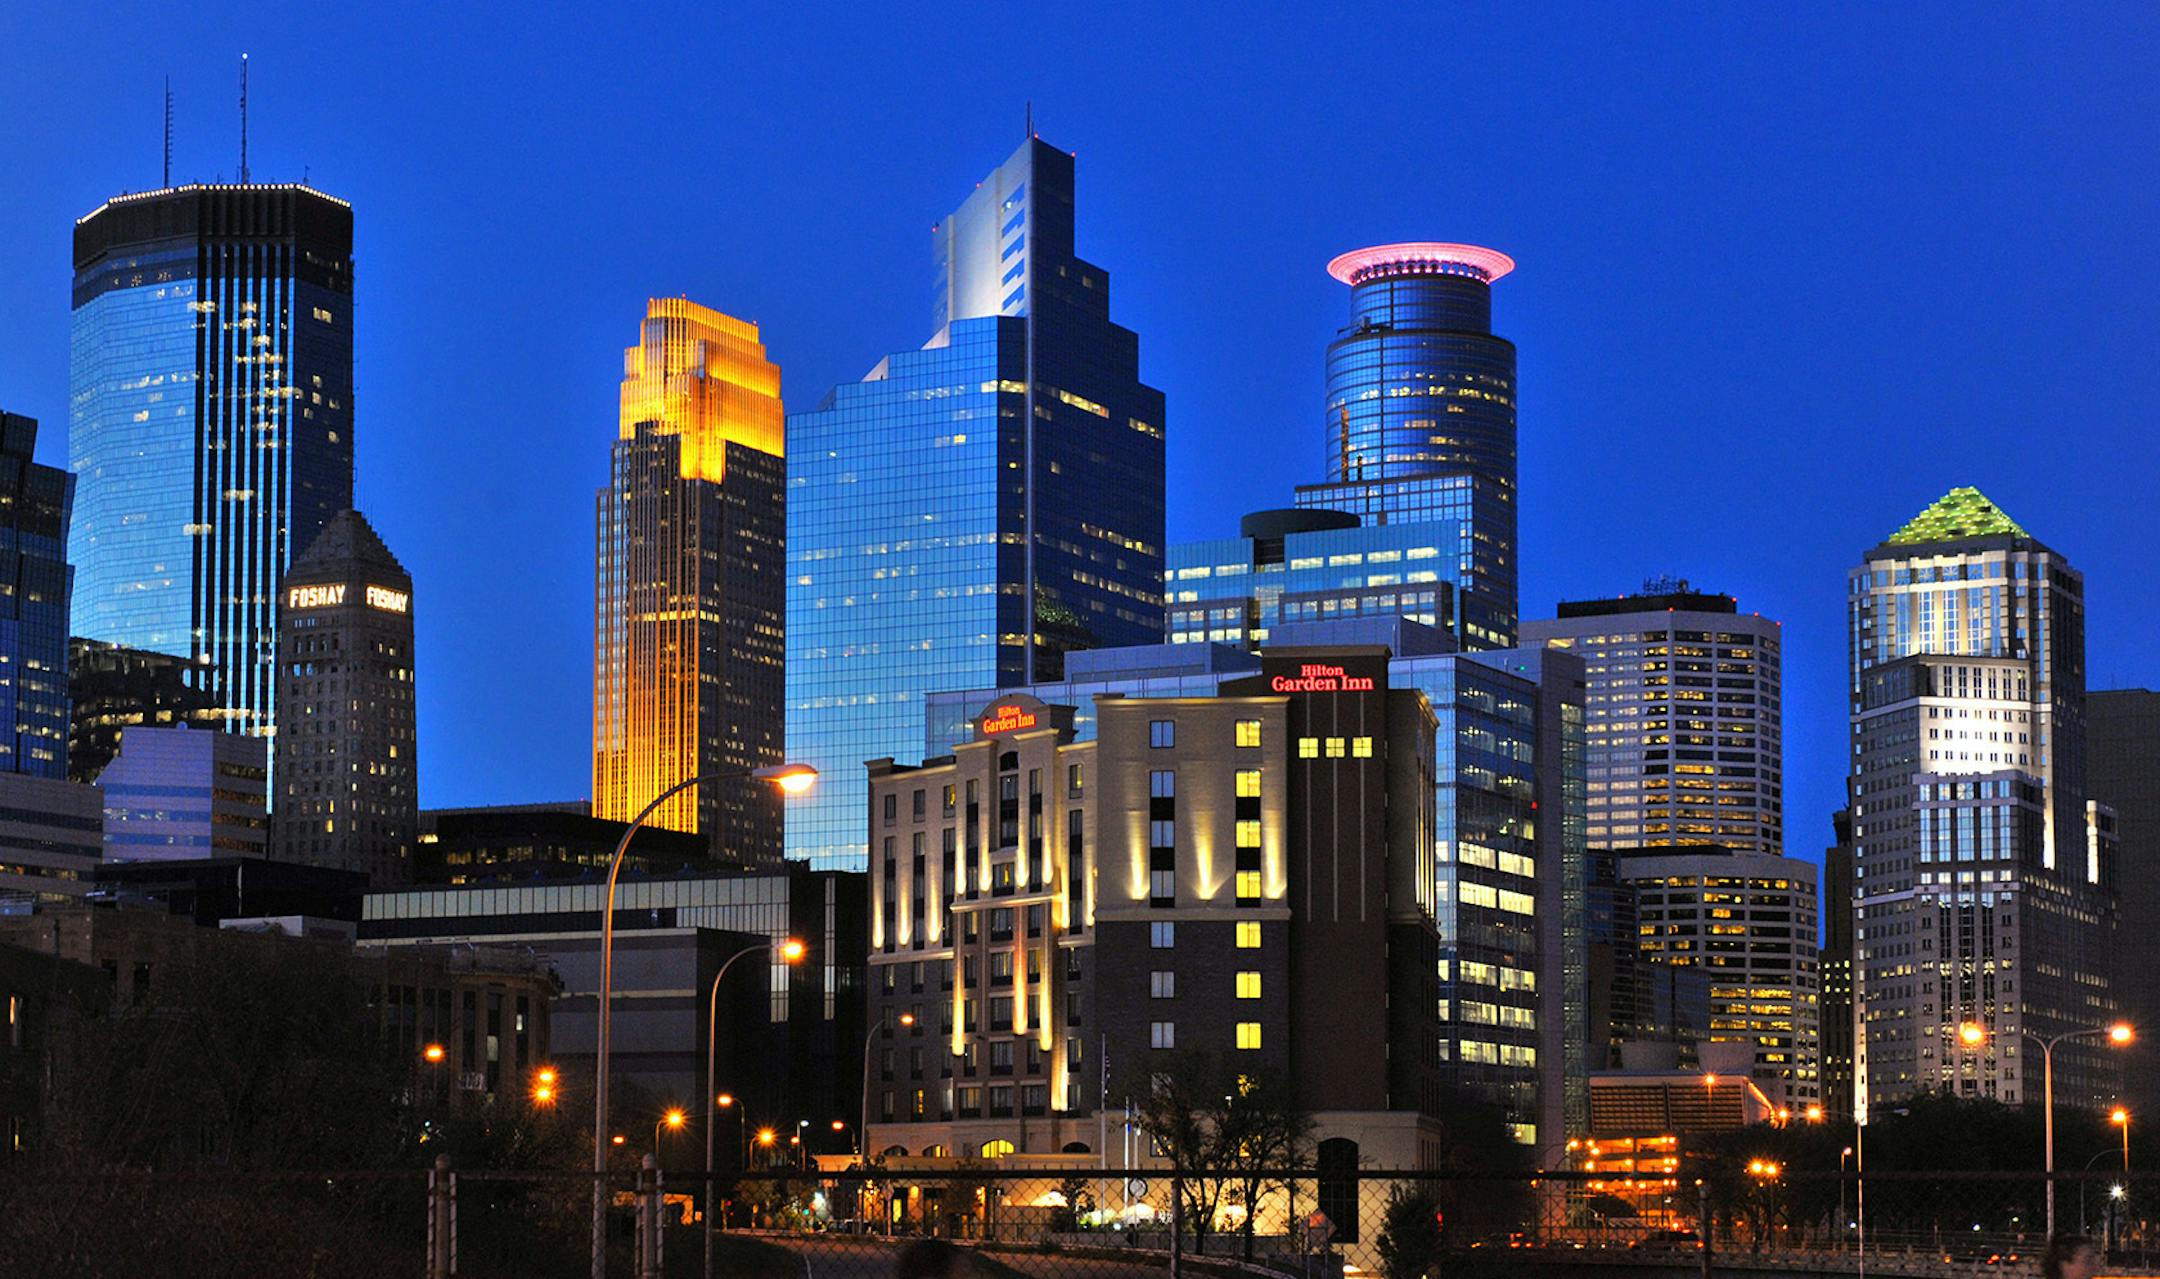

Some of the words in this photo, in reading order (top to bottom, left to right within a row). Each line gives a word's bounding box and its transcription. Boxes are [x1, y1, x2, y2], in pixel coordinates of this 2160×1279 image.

[289, 585, 346, 608] FOSHAY
[366, 586, 408, 612] FOSHAY
[1301, 664, 1344, 677] Hilton
[1271, 675, 1338, 692] Garden
[1341, 675, 1374, 690] Inn
[983, 717, 1017, 733] Garden
[1017, 713, 1035, 728] Inn
